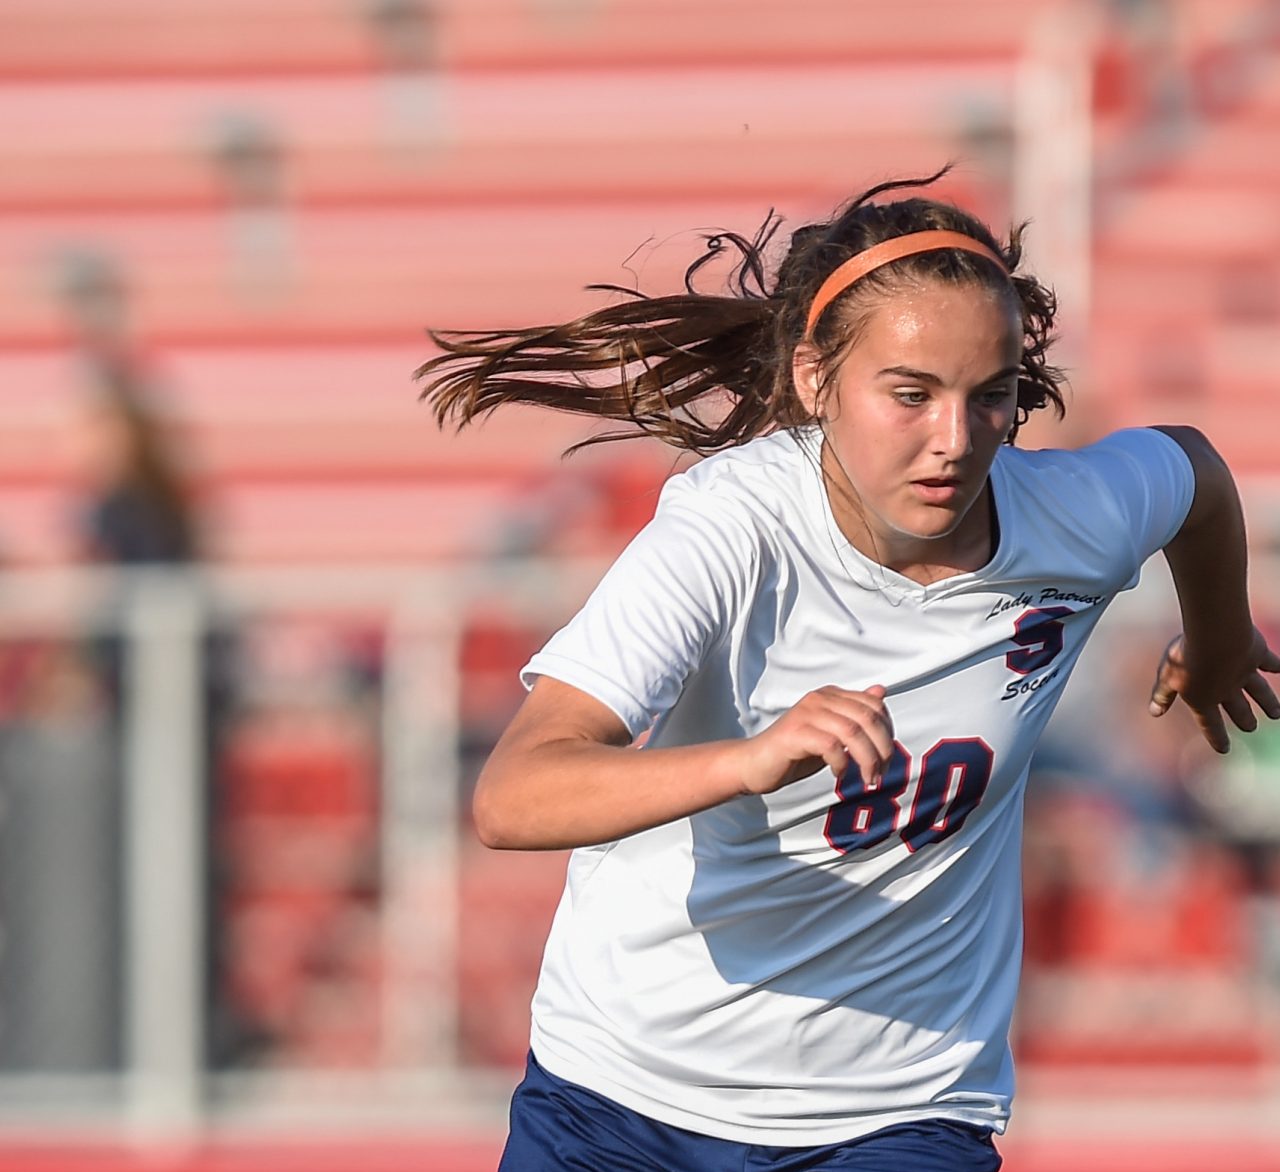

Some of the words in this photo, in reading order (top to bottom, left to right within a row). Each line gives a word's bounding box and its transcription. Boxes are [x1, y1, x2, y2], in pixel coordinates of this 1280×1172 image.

[985, 592, 1033, 621] Lady
[1005, 605, 1076, 675] S
[823, 737, 996, 854] 80
